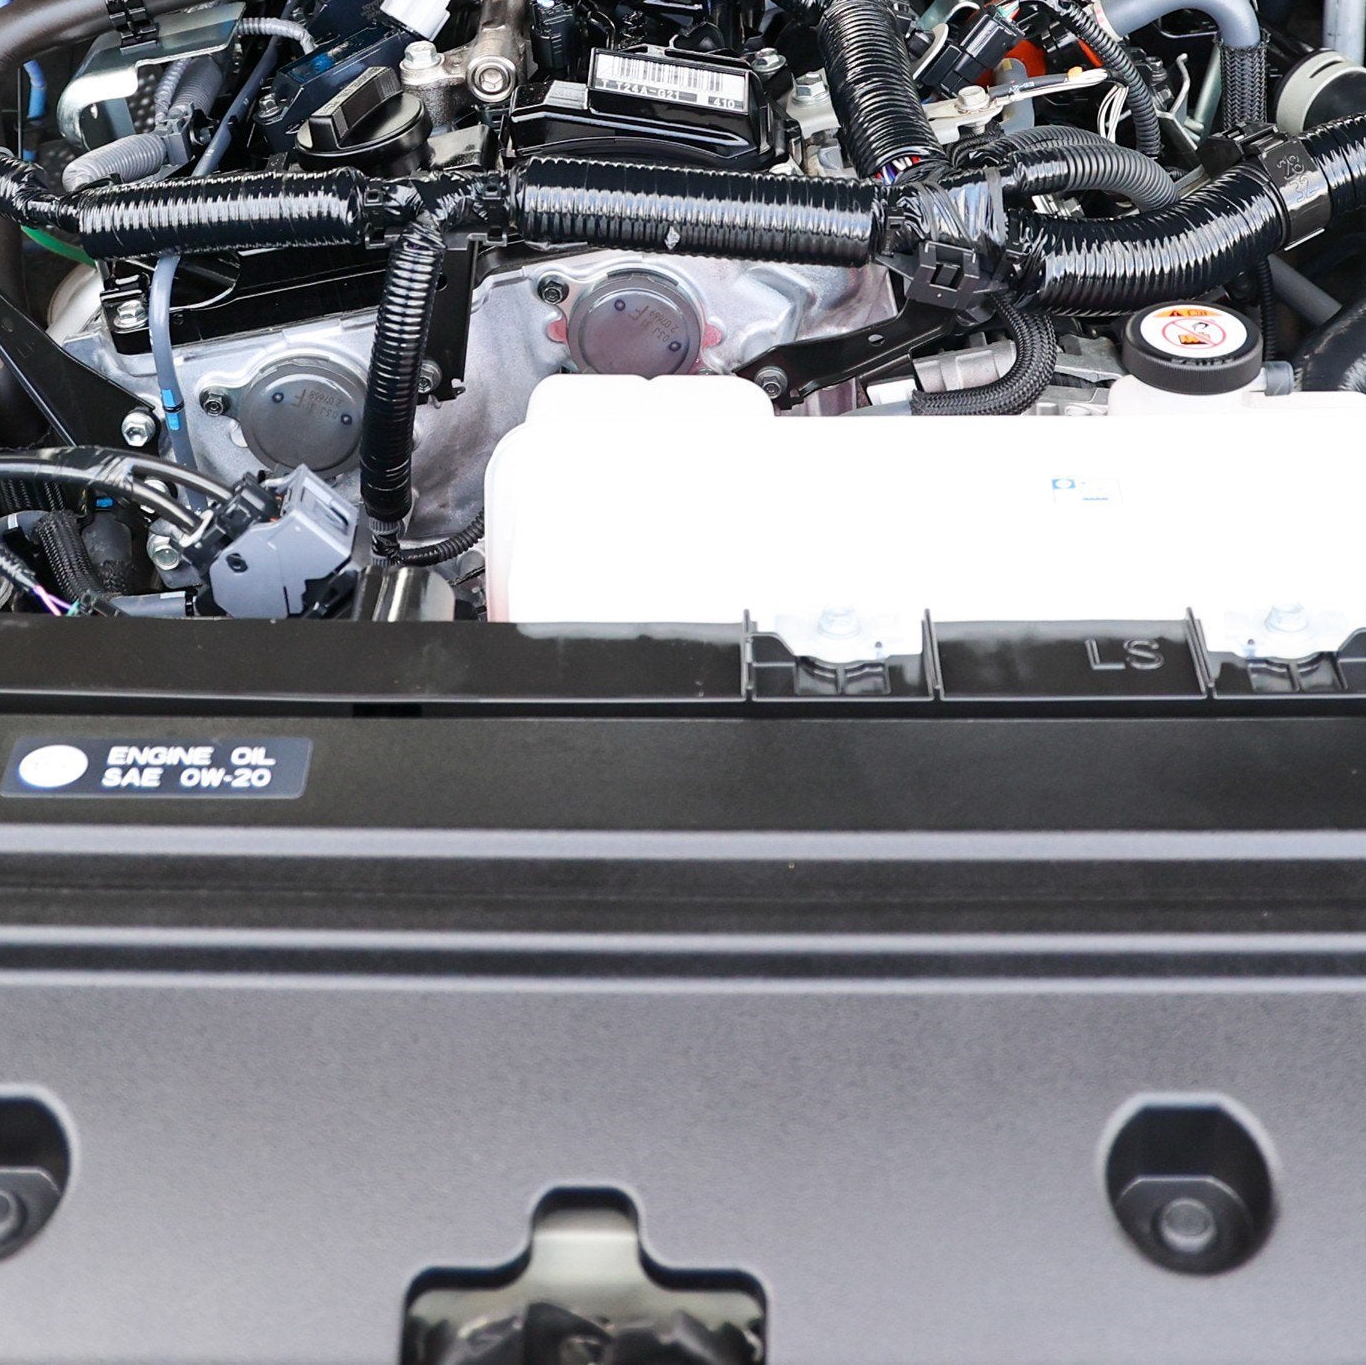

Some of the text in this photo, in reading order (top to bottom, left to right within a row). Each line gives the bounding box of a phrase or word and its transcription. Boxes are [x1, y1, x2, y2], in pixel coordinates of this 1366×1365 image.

[713, 97, 736, 109] 410
[1085, 639, 1166, 671] LS
[106, 746, 277, 766] ENGINE OIL
[101, 767, 273, 788] SAE 0W-20
